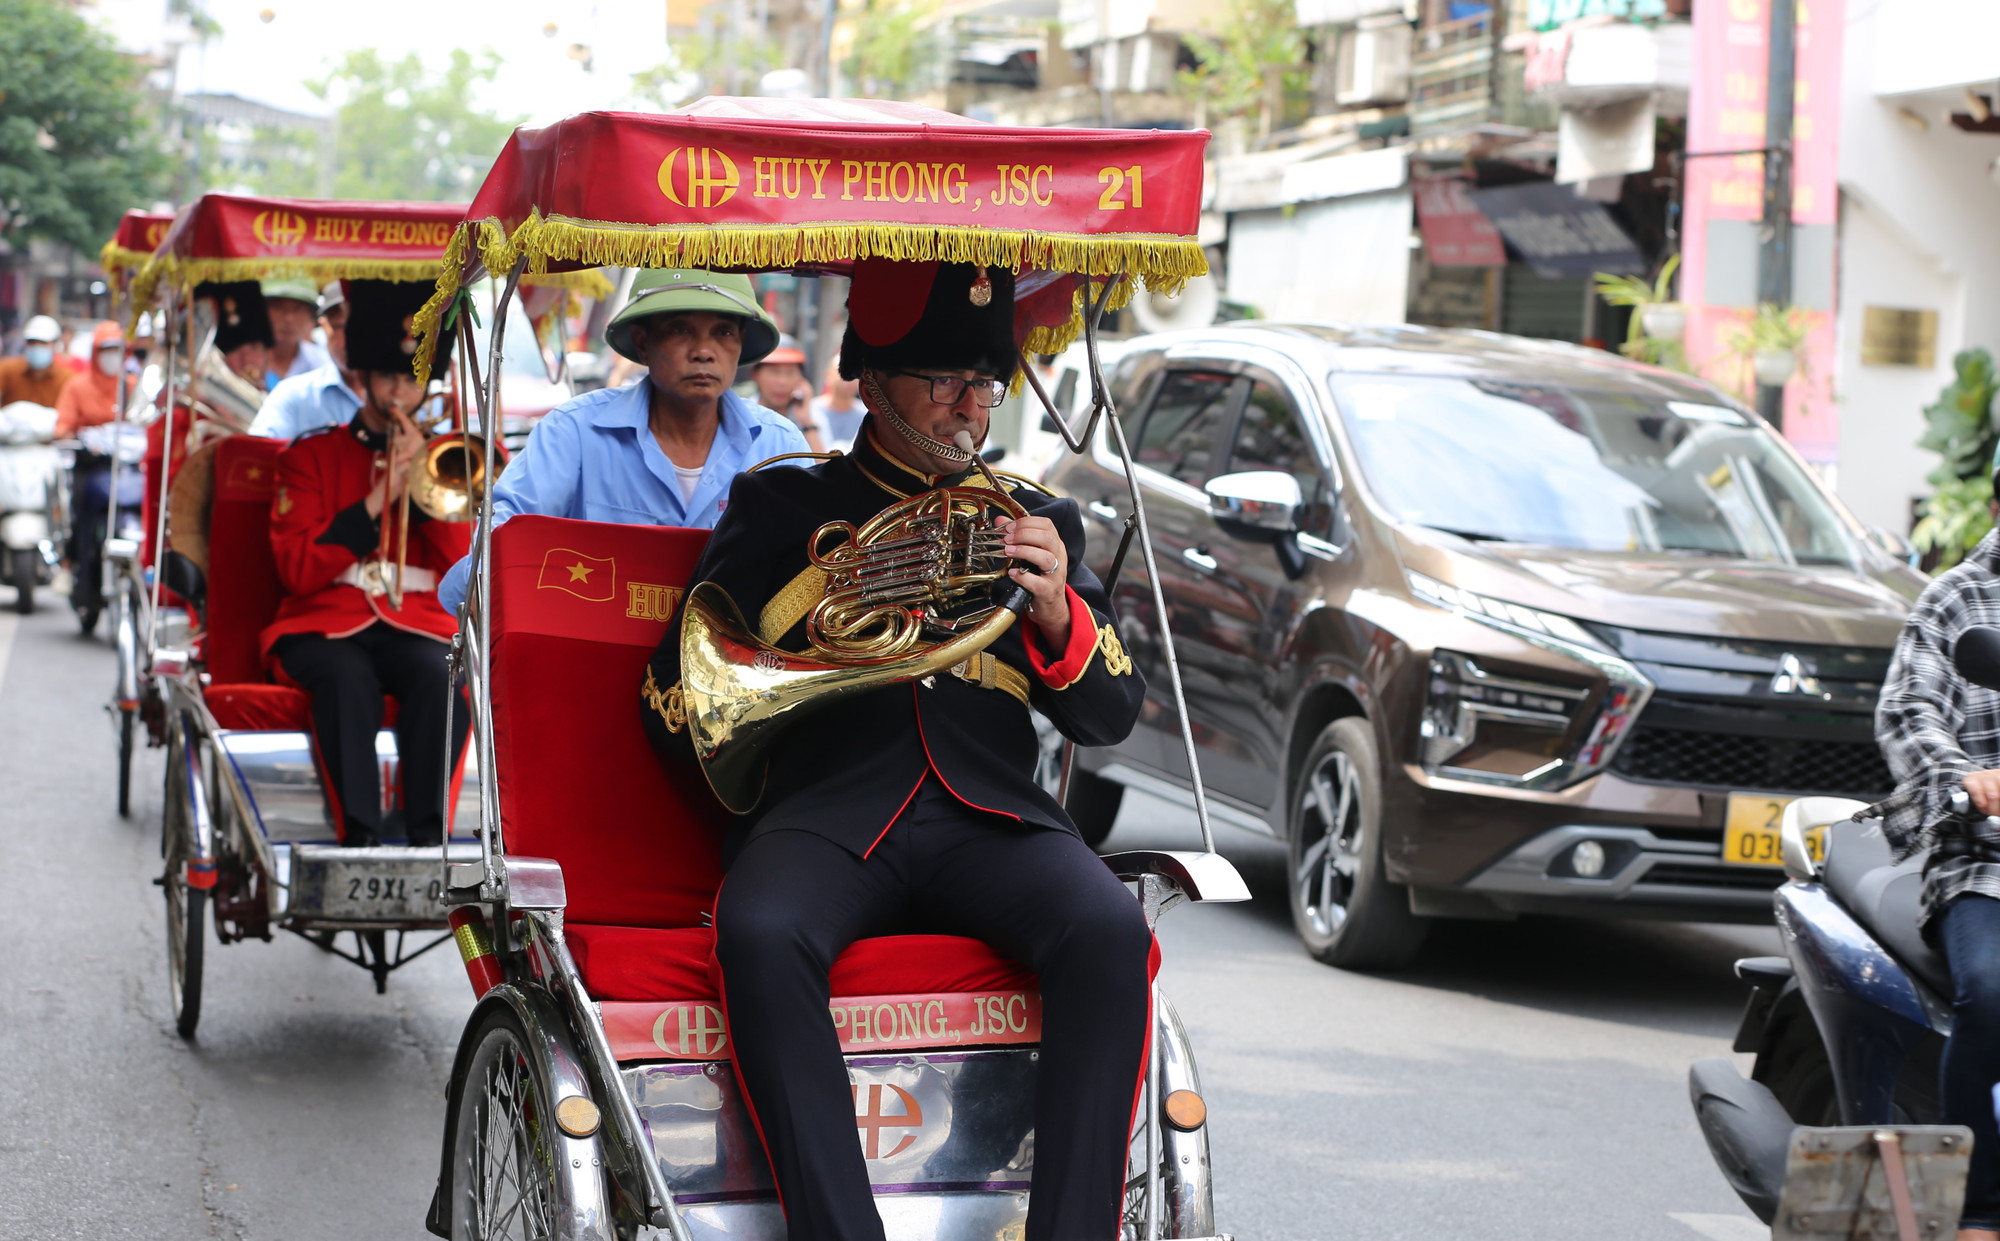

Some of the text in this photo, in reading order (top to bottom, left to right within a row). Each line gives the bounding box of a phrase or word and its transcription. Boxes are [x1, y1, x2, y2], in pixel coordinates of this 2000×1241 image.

[752, 156, 831, 201] HUY
[990, 164, 1054, 208] JSC
[1097, 165, 1143, 211] 21
[314, 217, 368, 244] HUY
[369, 219, 449, 248] PHONG
[969, 993, 1028, 1036] JSC
